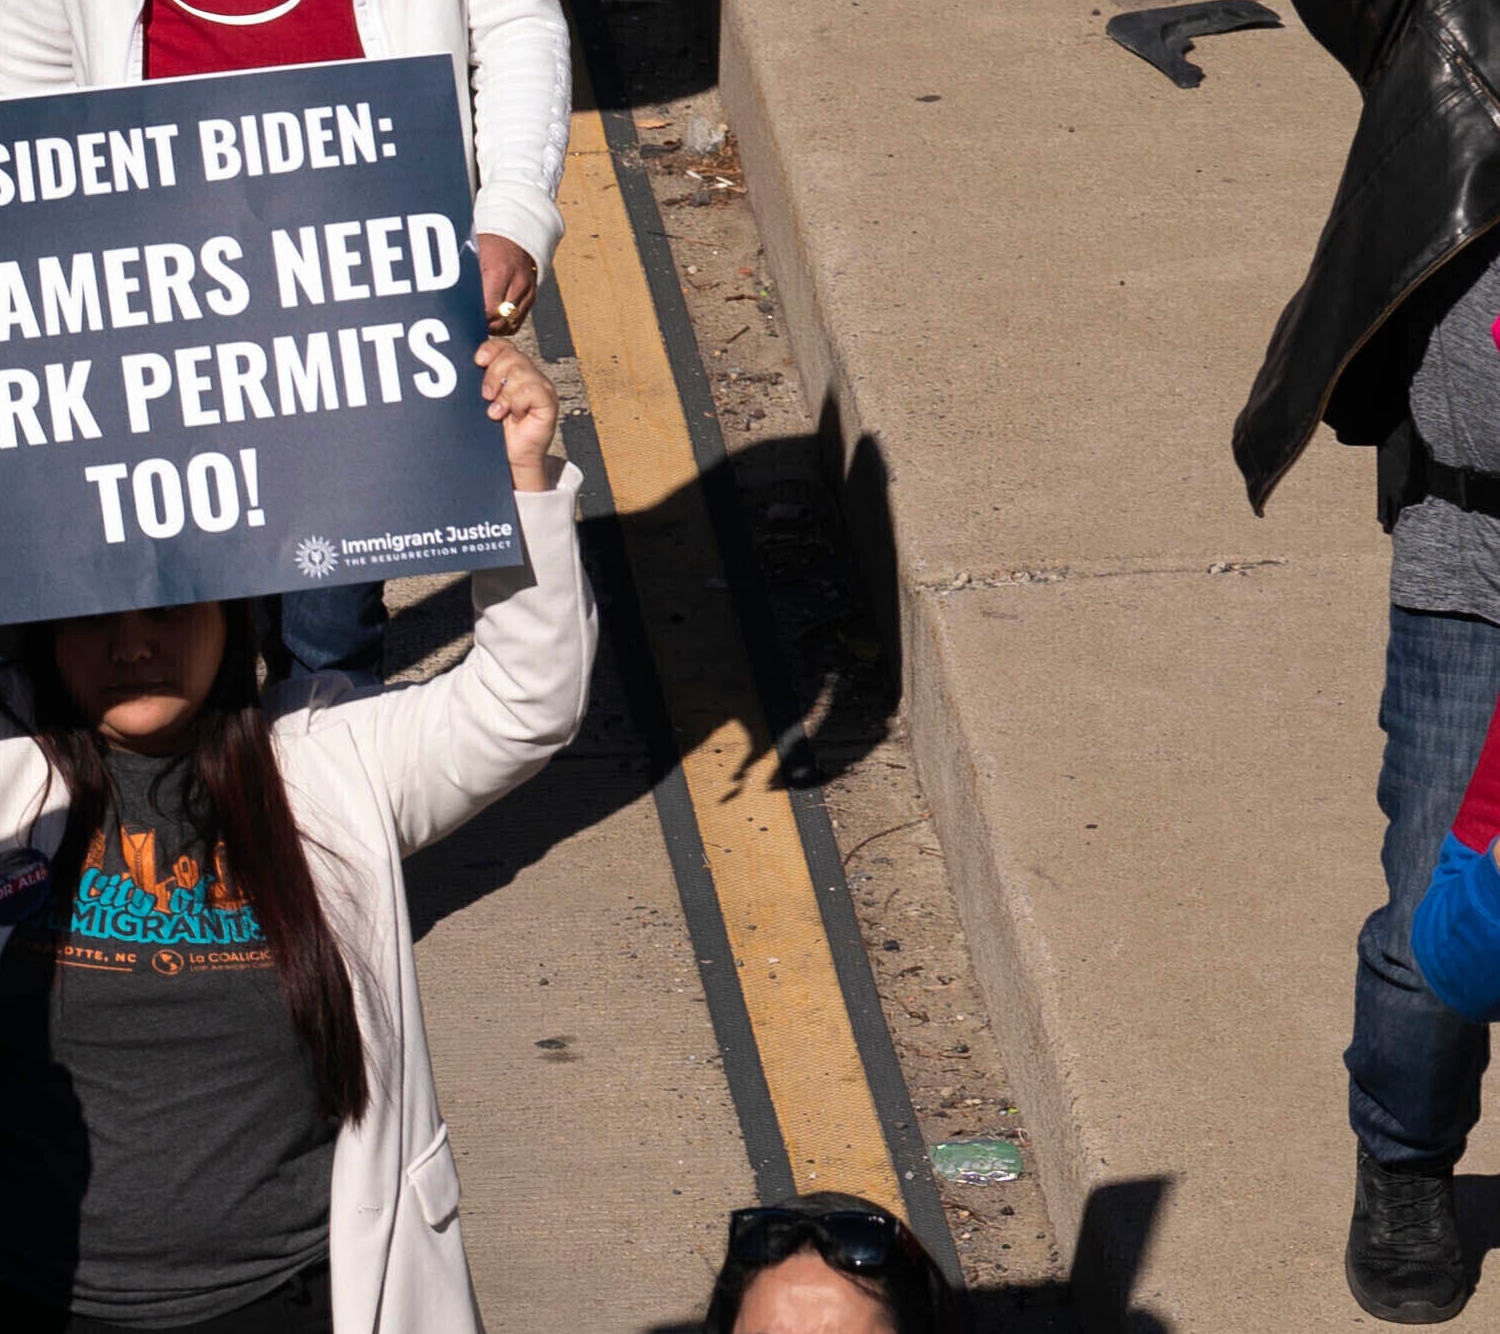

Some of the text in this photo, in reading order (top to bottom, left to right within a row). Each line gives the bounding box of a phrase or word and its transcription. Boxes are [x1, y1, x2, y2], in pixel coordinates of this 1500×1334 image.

[199, 102, 400, 179] BIDEN:
[278, 213, 463, 304] NEED
[127, 317, 459, 432] PERMITS
[85, 452, 269, 544] TOO!
[341, 521, 513, 555] Immigrant Justice
[343, 540, 512, 567] THE RESURRECTION PROJECT
[79, 866, 156, 917] City
[115, 952, 137, 964] NC
